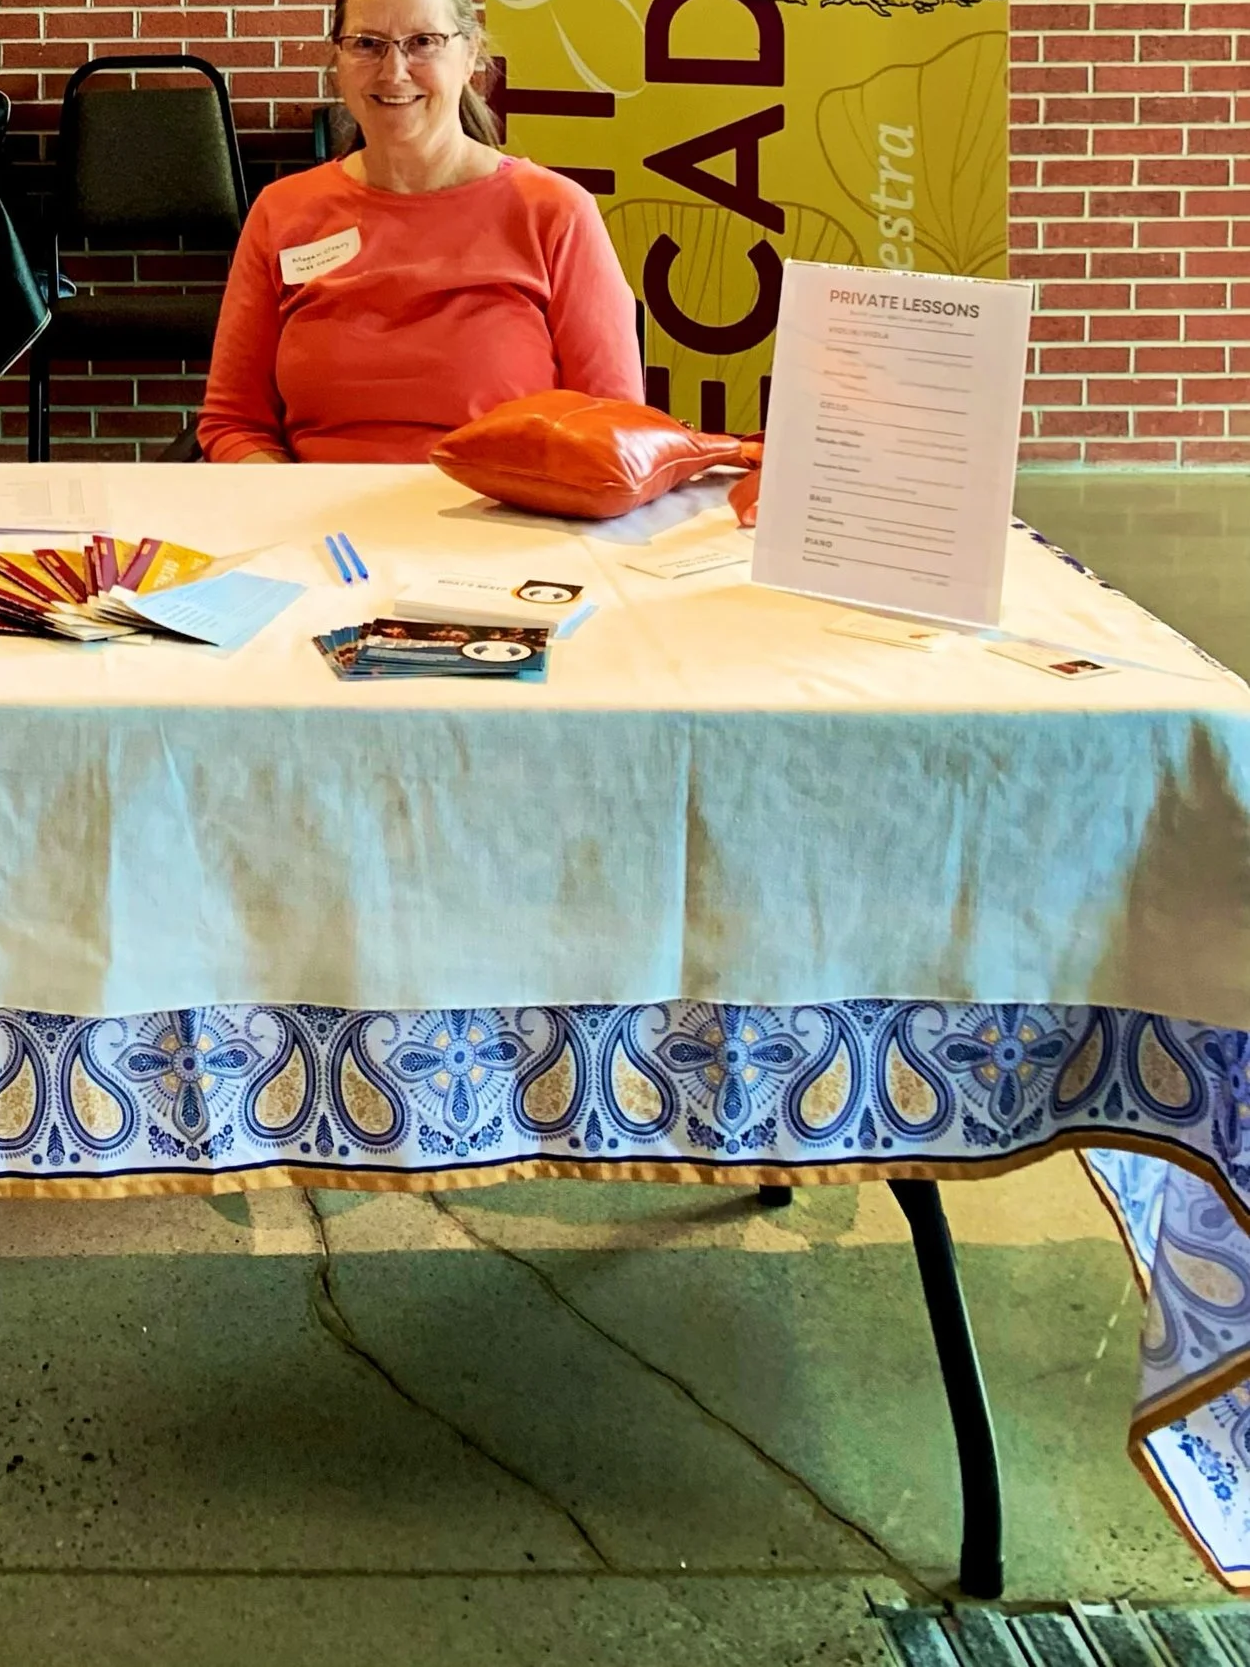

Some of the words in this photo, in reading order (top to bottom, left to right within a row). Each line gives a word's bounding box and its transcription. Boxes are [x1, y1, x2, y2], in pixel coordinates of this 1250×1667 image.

[829, 289, 899, 311] PRIVATE
[902, 296, 980, 319] LESSONS
[804, 536, 833, 549] PIANO
